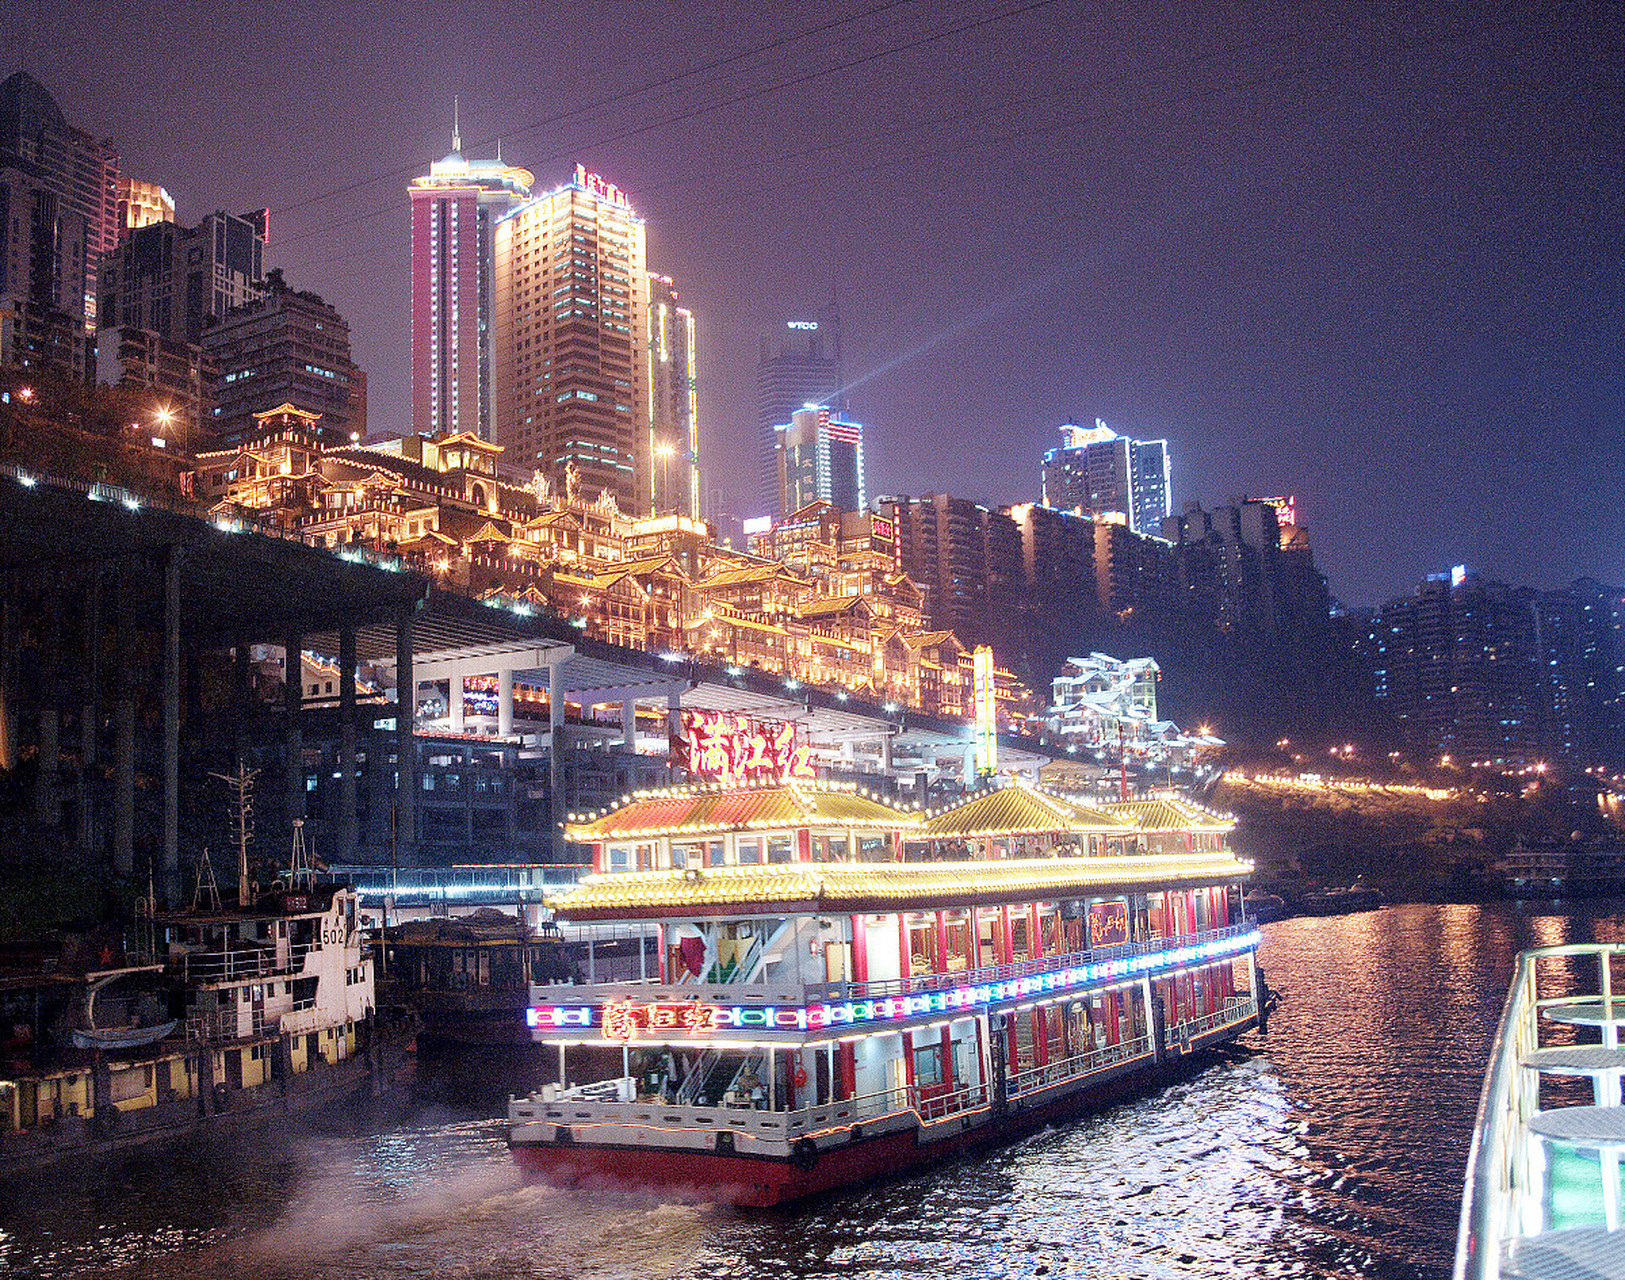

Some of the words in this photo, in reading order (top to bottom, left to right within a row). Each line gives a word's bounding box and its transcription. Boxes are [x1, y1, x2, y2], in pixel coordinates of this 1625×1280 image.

[689, 710, 816, 782] 满江红
[323, 929, 344, 944] 502
